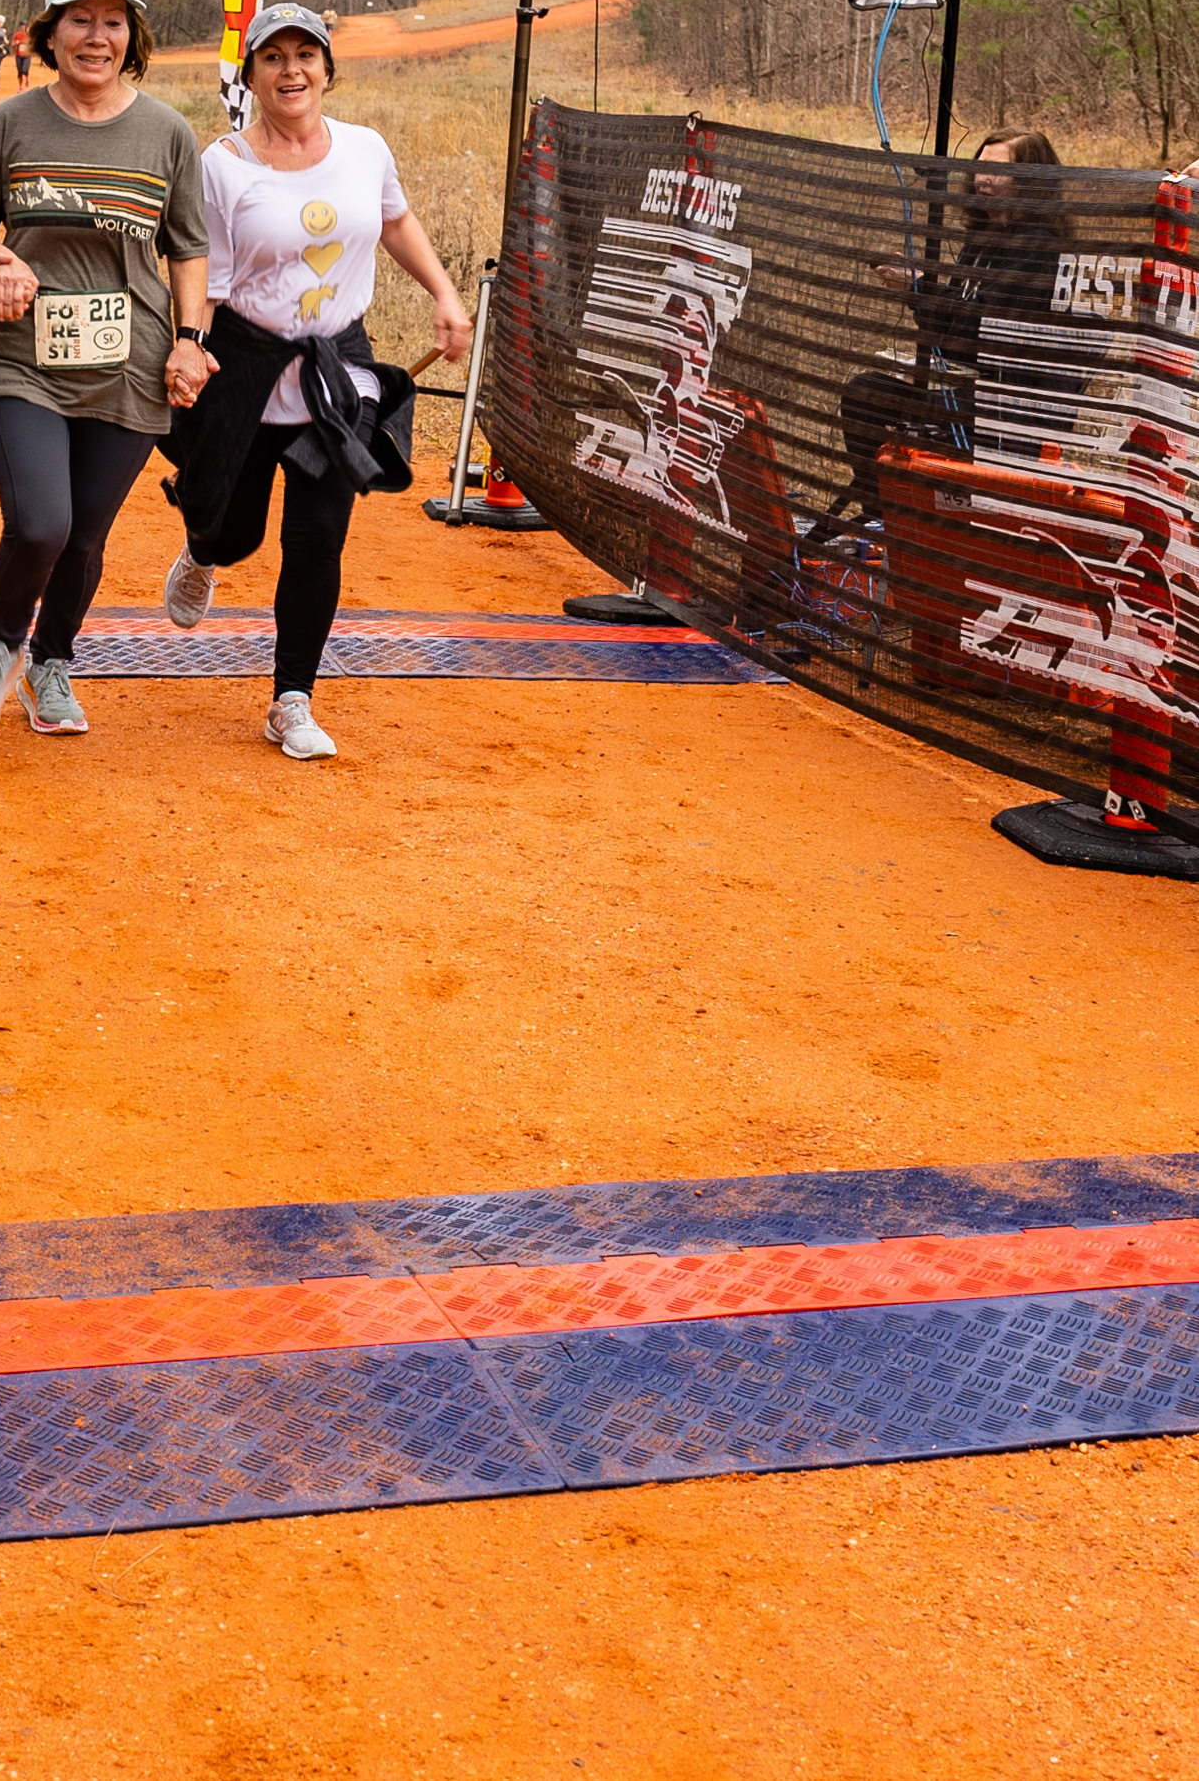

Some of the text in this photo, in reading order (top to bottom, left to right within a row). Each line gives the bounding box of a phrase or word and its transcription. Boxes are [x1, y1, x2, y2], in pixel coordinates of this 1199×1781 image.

[641, 168, 742, 231] BEST TIMES
[94, 217, 128, 233] WOLF
[1050, 253, 1199, 336] BEST TI
[89, 297, 125, 322] 212
[51, 322, 81, 338] RE
[103, 333, 115, 345] 5K
[73, 338, 81, 359] RUN
